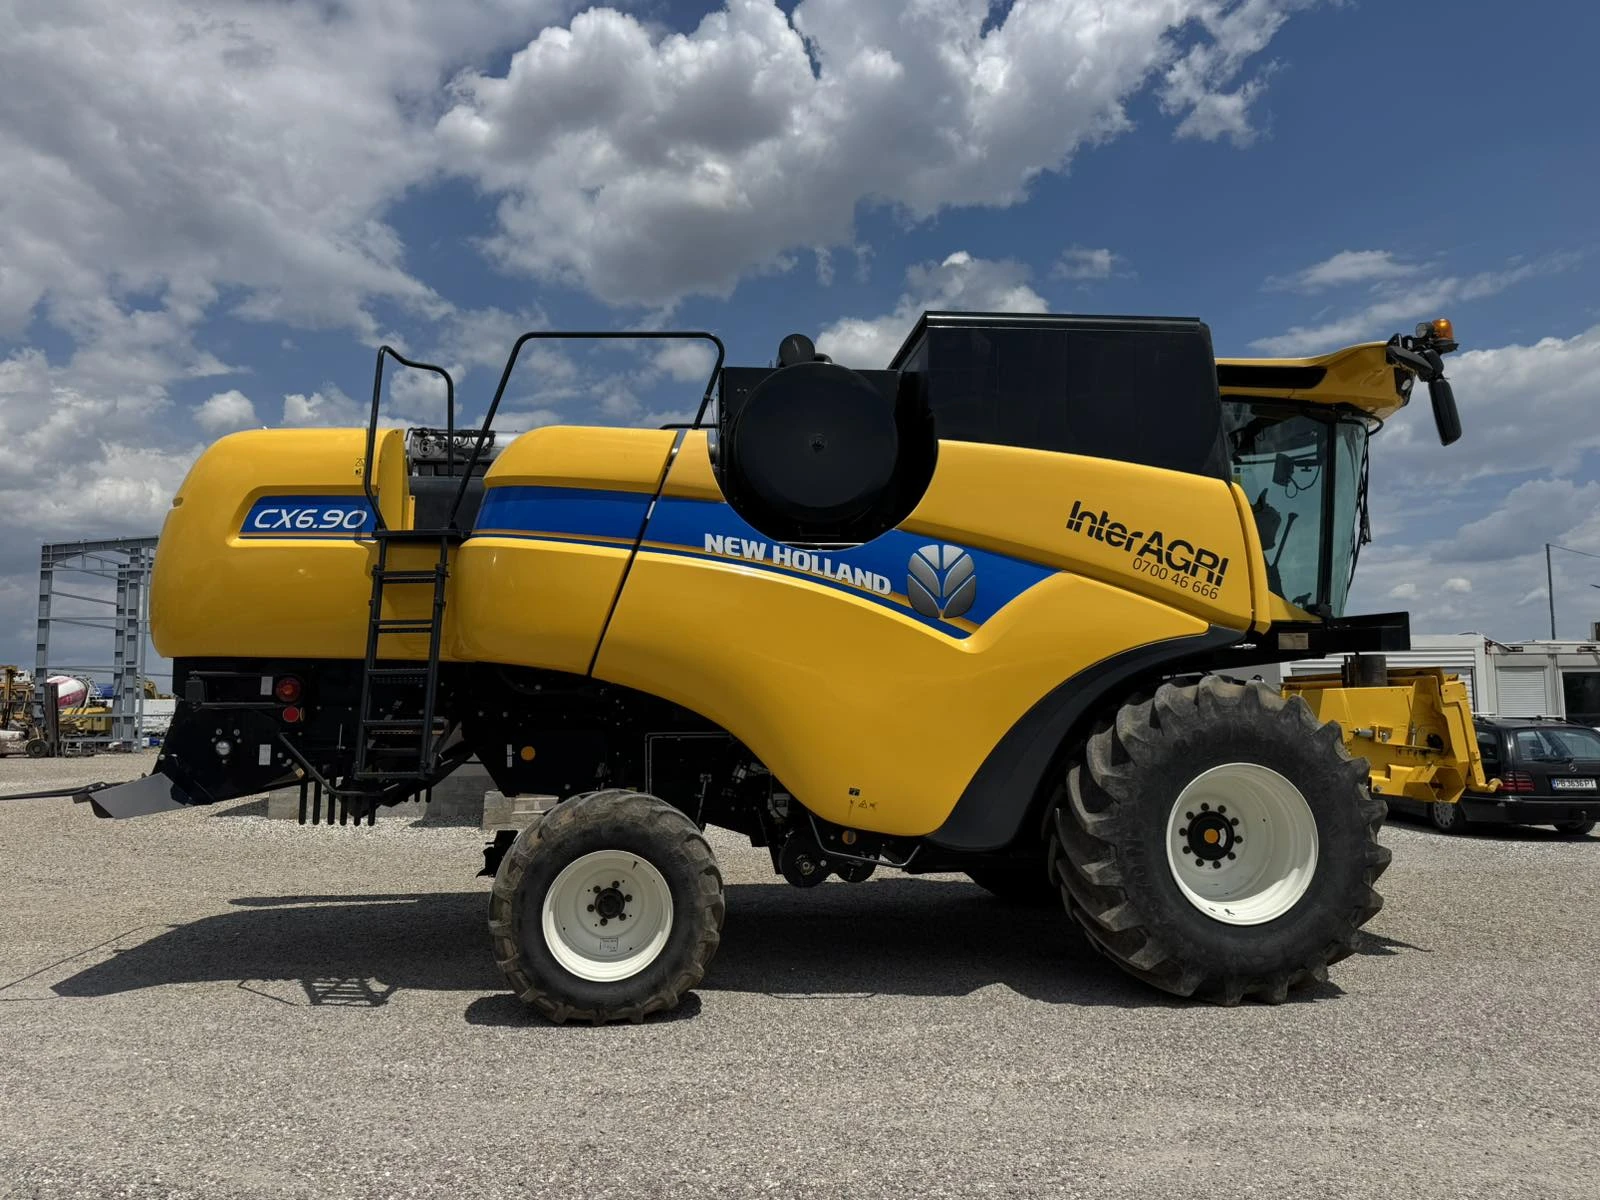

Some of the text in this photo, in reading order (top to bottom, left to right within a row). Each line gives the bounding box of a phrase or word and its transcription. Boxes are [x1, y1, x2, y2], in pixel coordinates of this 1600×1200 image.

[254, 508, 368, 529] CX6.90
[1065, 500, 1229, 587] InterAGRI
[704, 533, 892, 595] NEW HOLLAND
[1132, 557, 1219, 600] 0700 46 666
